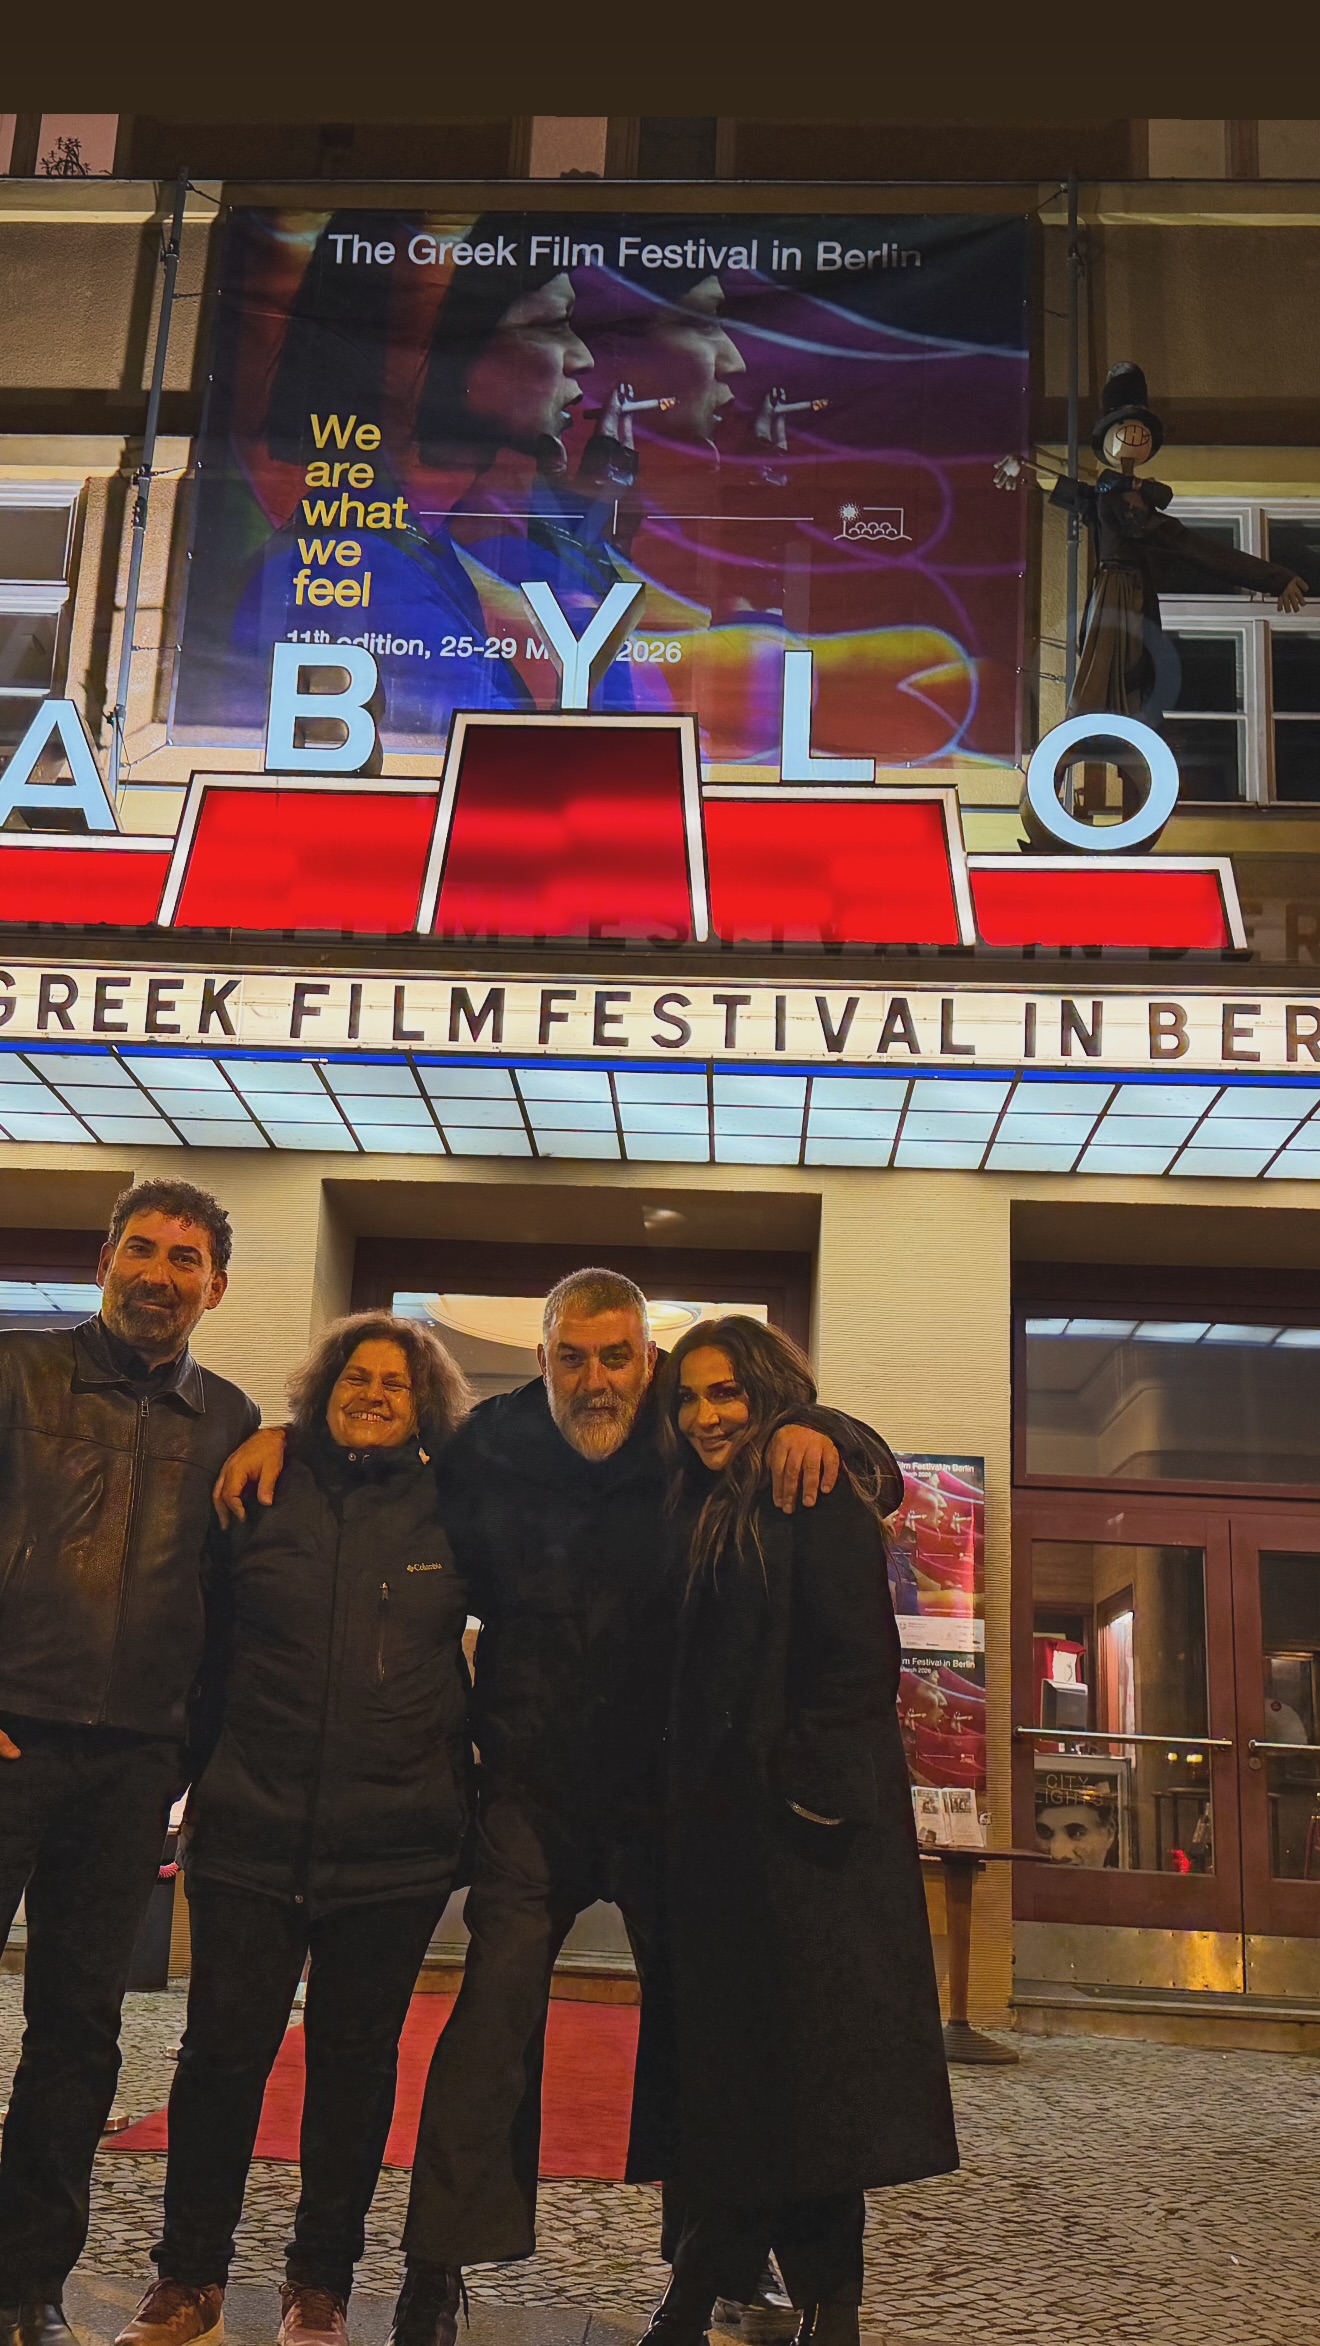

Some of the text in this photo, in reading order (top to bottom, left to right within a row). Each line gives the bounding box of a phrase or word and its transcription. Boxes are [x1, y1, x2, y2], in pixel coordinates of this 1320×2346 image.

[328, 234, 922, 272] The Greek Film Festival in Berlin
[310, 413, 382, 451] We
[304, 461, 375, 489] are
[301, 492, 409, 530] what
[297, 538, 362, 567] we
[292, 568, 372, 608] feel
[439, 636, 518, 660] 25-29
[615, 640, 683, 663] 2026
[1023, 999, 1105, 1058] IN
[912, 1657, 942, 1667] Festival
[943, 1659, 951, 1669] in
[953, 1660, 976, 1670] Berlin
